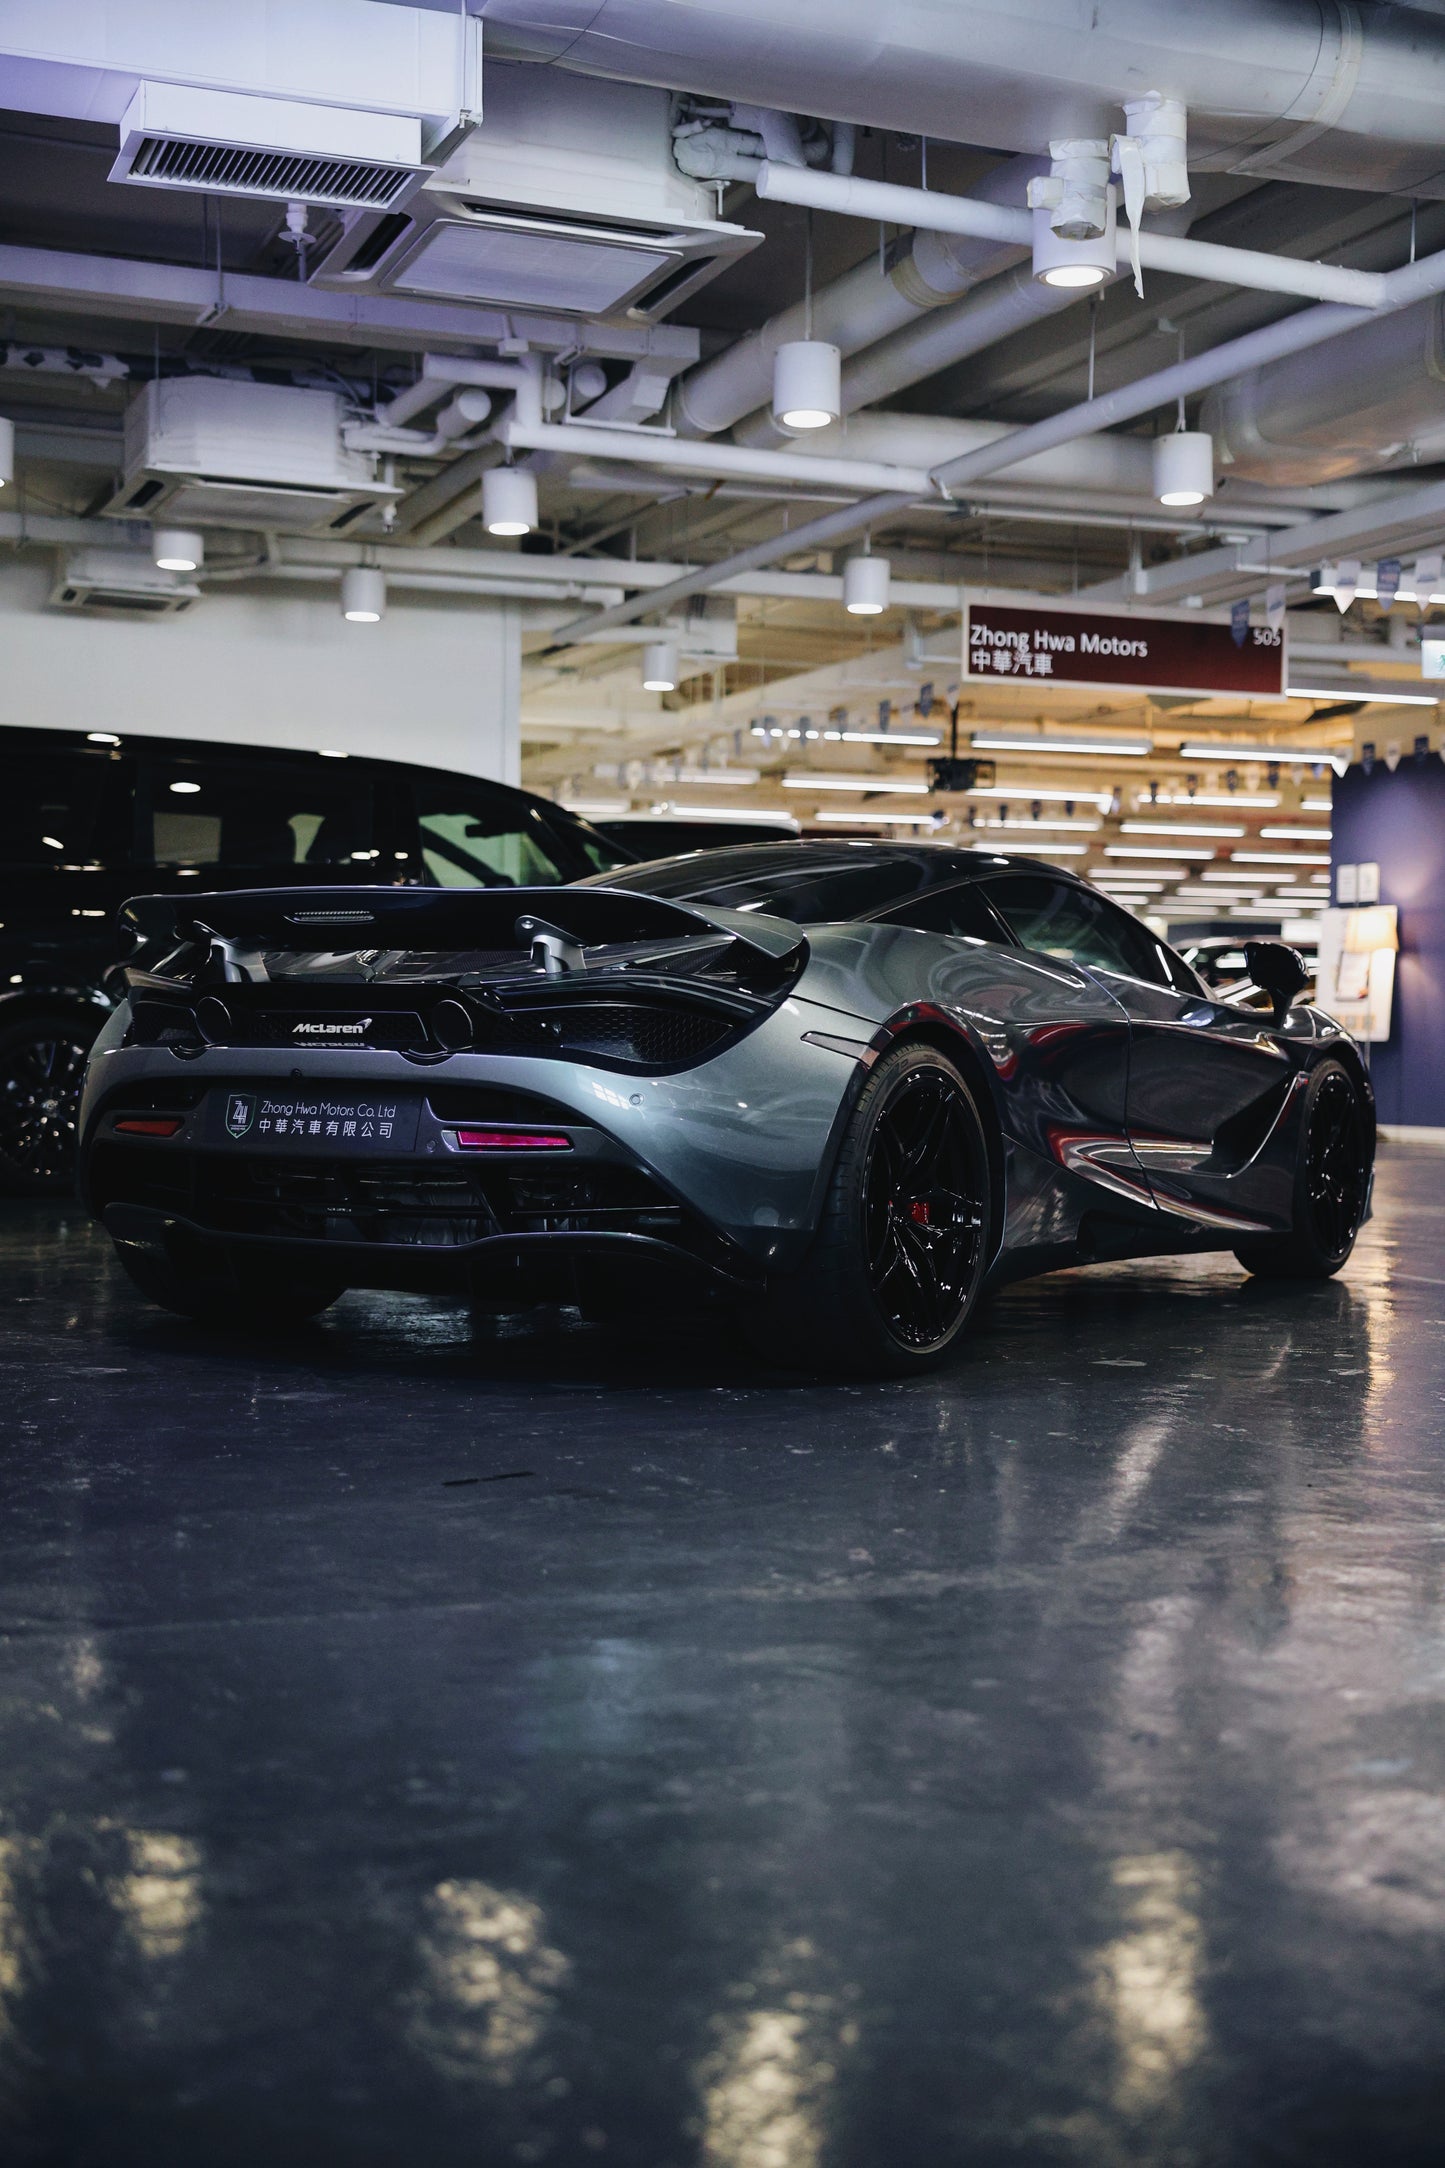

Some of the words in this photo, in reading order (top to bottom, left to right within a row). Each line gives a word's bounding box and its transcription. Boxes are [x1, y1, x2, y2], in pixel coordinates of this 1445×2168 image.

[970, 624, 1030, 652] Zhong
[1034, 629, 1076, 652] Hwa
[1080, 633, 1148, 658] Motors
[971, 648, 1053, 676] 中華汽車
[292, 1023, 364, 1034] McLaren
[261, 1100, 293, 1116] Zhong
[295, 1102, 317, 1115] Hwa
[319, 1102, 354, 1116] Motors
[357, 1104, 375, 1117] Co.
[378, 1105, 396, 1118] Ltd
[259, 1118, 393, 1138] 中華汽車有限公司
